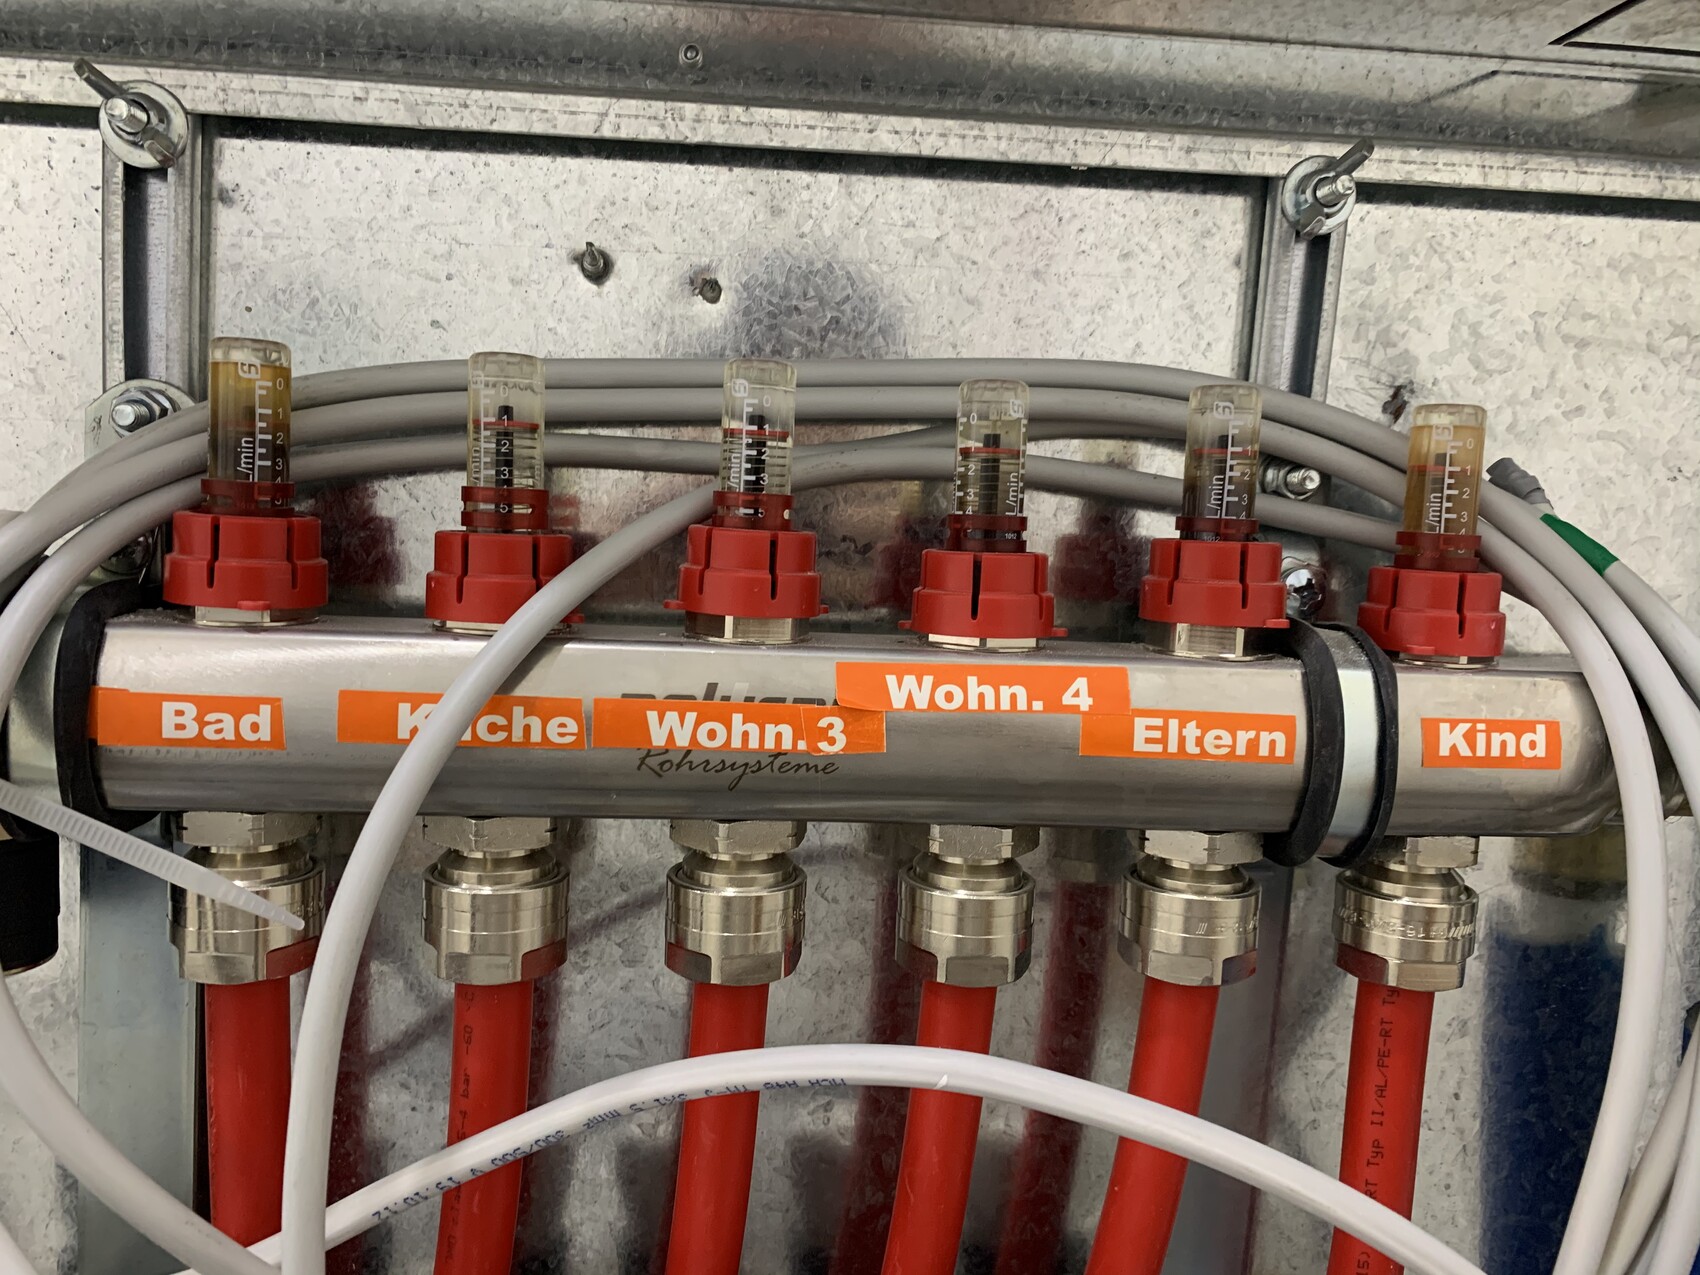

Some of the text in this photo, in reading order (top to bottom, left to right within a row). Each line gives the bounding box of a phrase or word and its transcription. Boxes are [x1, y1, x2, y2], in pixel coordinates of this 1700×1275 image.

[276, 378, 284, 390] 0
[500, 385, 509, 397] 0
[763, 395, 771, 407] 0
[277, 408, 283, 419] 1
[970, 412, 978, 425] 0
[502, 415, 508, 426] 1
[763, 424, 769, 435] 1
[276, 433, 283, 444] 2
[1466, 438, 1474, 449] 0
[500, 440, 509, 452] 2
[1247, 446, 1252, 456] 1
[761, 448, 770, 460] 2
[275, 459, 283, 470] 3
[471, 447, 481, 487] /min
[967, 464, 976, 476] 2
[1465, 465, 1471, 476] 1
[500, 467, 509, 479] 3
[760, 473, 769, 485] 3
[1243, 469, 1251, 481] 2
[967, 489, 975, 500] 3
[1005, 472, 1019, 515] L/min
[1462, 487, 1470, 499] 2
[1241, 494, 1249, 505] 3
[500, 501, 509, 513] 5
[965, 505, 973, 515] 4
[1460, 511, 1468, 522] 3
[886, 675, 1093, 713] Wohn. 4
[161, 701, 271, 741] Bad
[397, 702, 579, 744] Kche
[646, 710, 847, 752] Wohn. 3
[1133, 717, 1287, 757] Eltern
[1438, 722, 1547, 759] Kind
[1371, 1017, 1393, 1127] II/AL/PE-RT
[1366, 1139, 1385, 1167] Typ
